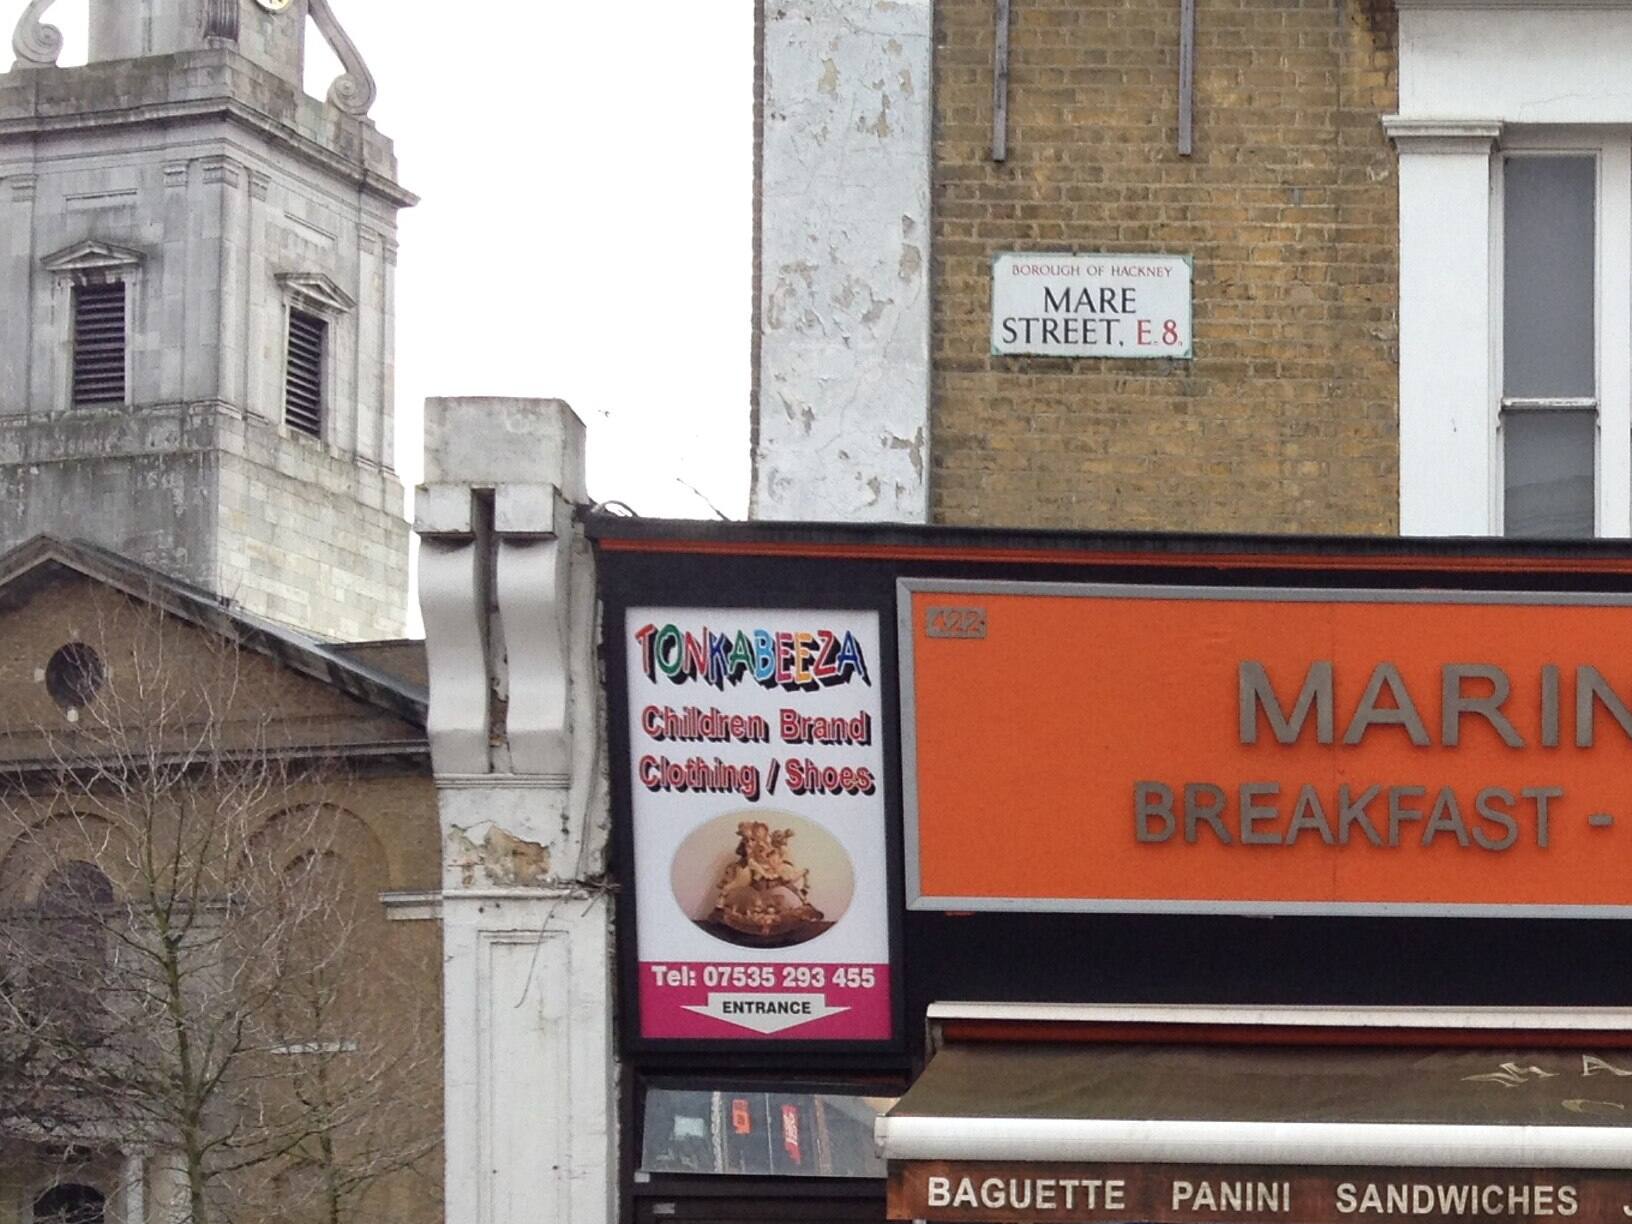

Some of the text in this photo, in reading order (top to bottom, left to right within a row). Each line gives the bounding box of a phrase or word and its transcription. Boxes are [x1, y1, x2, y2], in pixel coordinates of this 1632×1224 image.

[1012, 264, 1173, 277] BOROUGH OF HACKNEY
[1044, 286, 1136, 314] MARE
[1002, 317, 1124, 347] STREET,
[634, 623, 872, 692] TONKABEEZA
[641, 705, 871, 746] Children Brand
[639, 755, 760, 802] Clothing
[784, 758, 876, 796] Shoes
[1133, 780, 1565, 852] BREAKFAST
[651, 966, 876, 989] Tel: 07535 293 455
[722, 1001, 812, 1015] ENTRANCE
[928, 1176, 1126, 1211] BAGUETTE
[1172, 1181, 1290, 1212] PANINI
[1335, 1182, 1579, 1216] SANDWICHES
